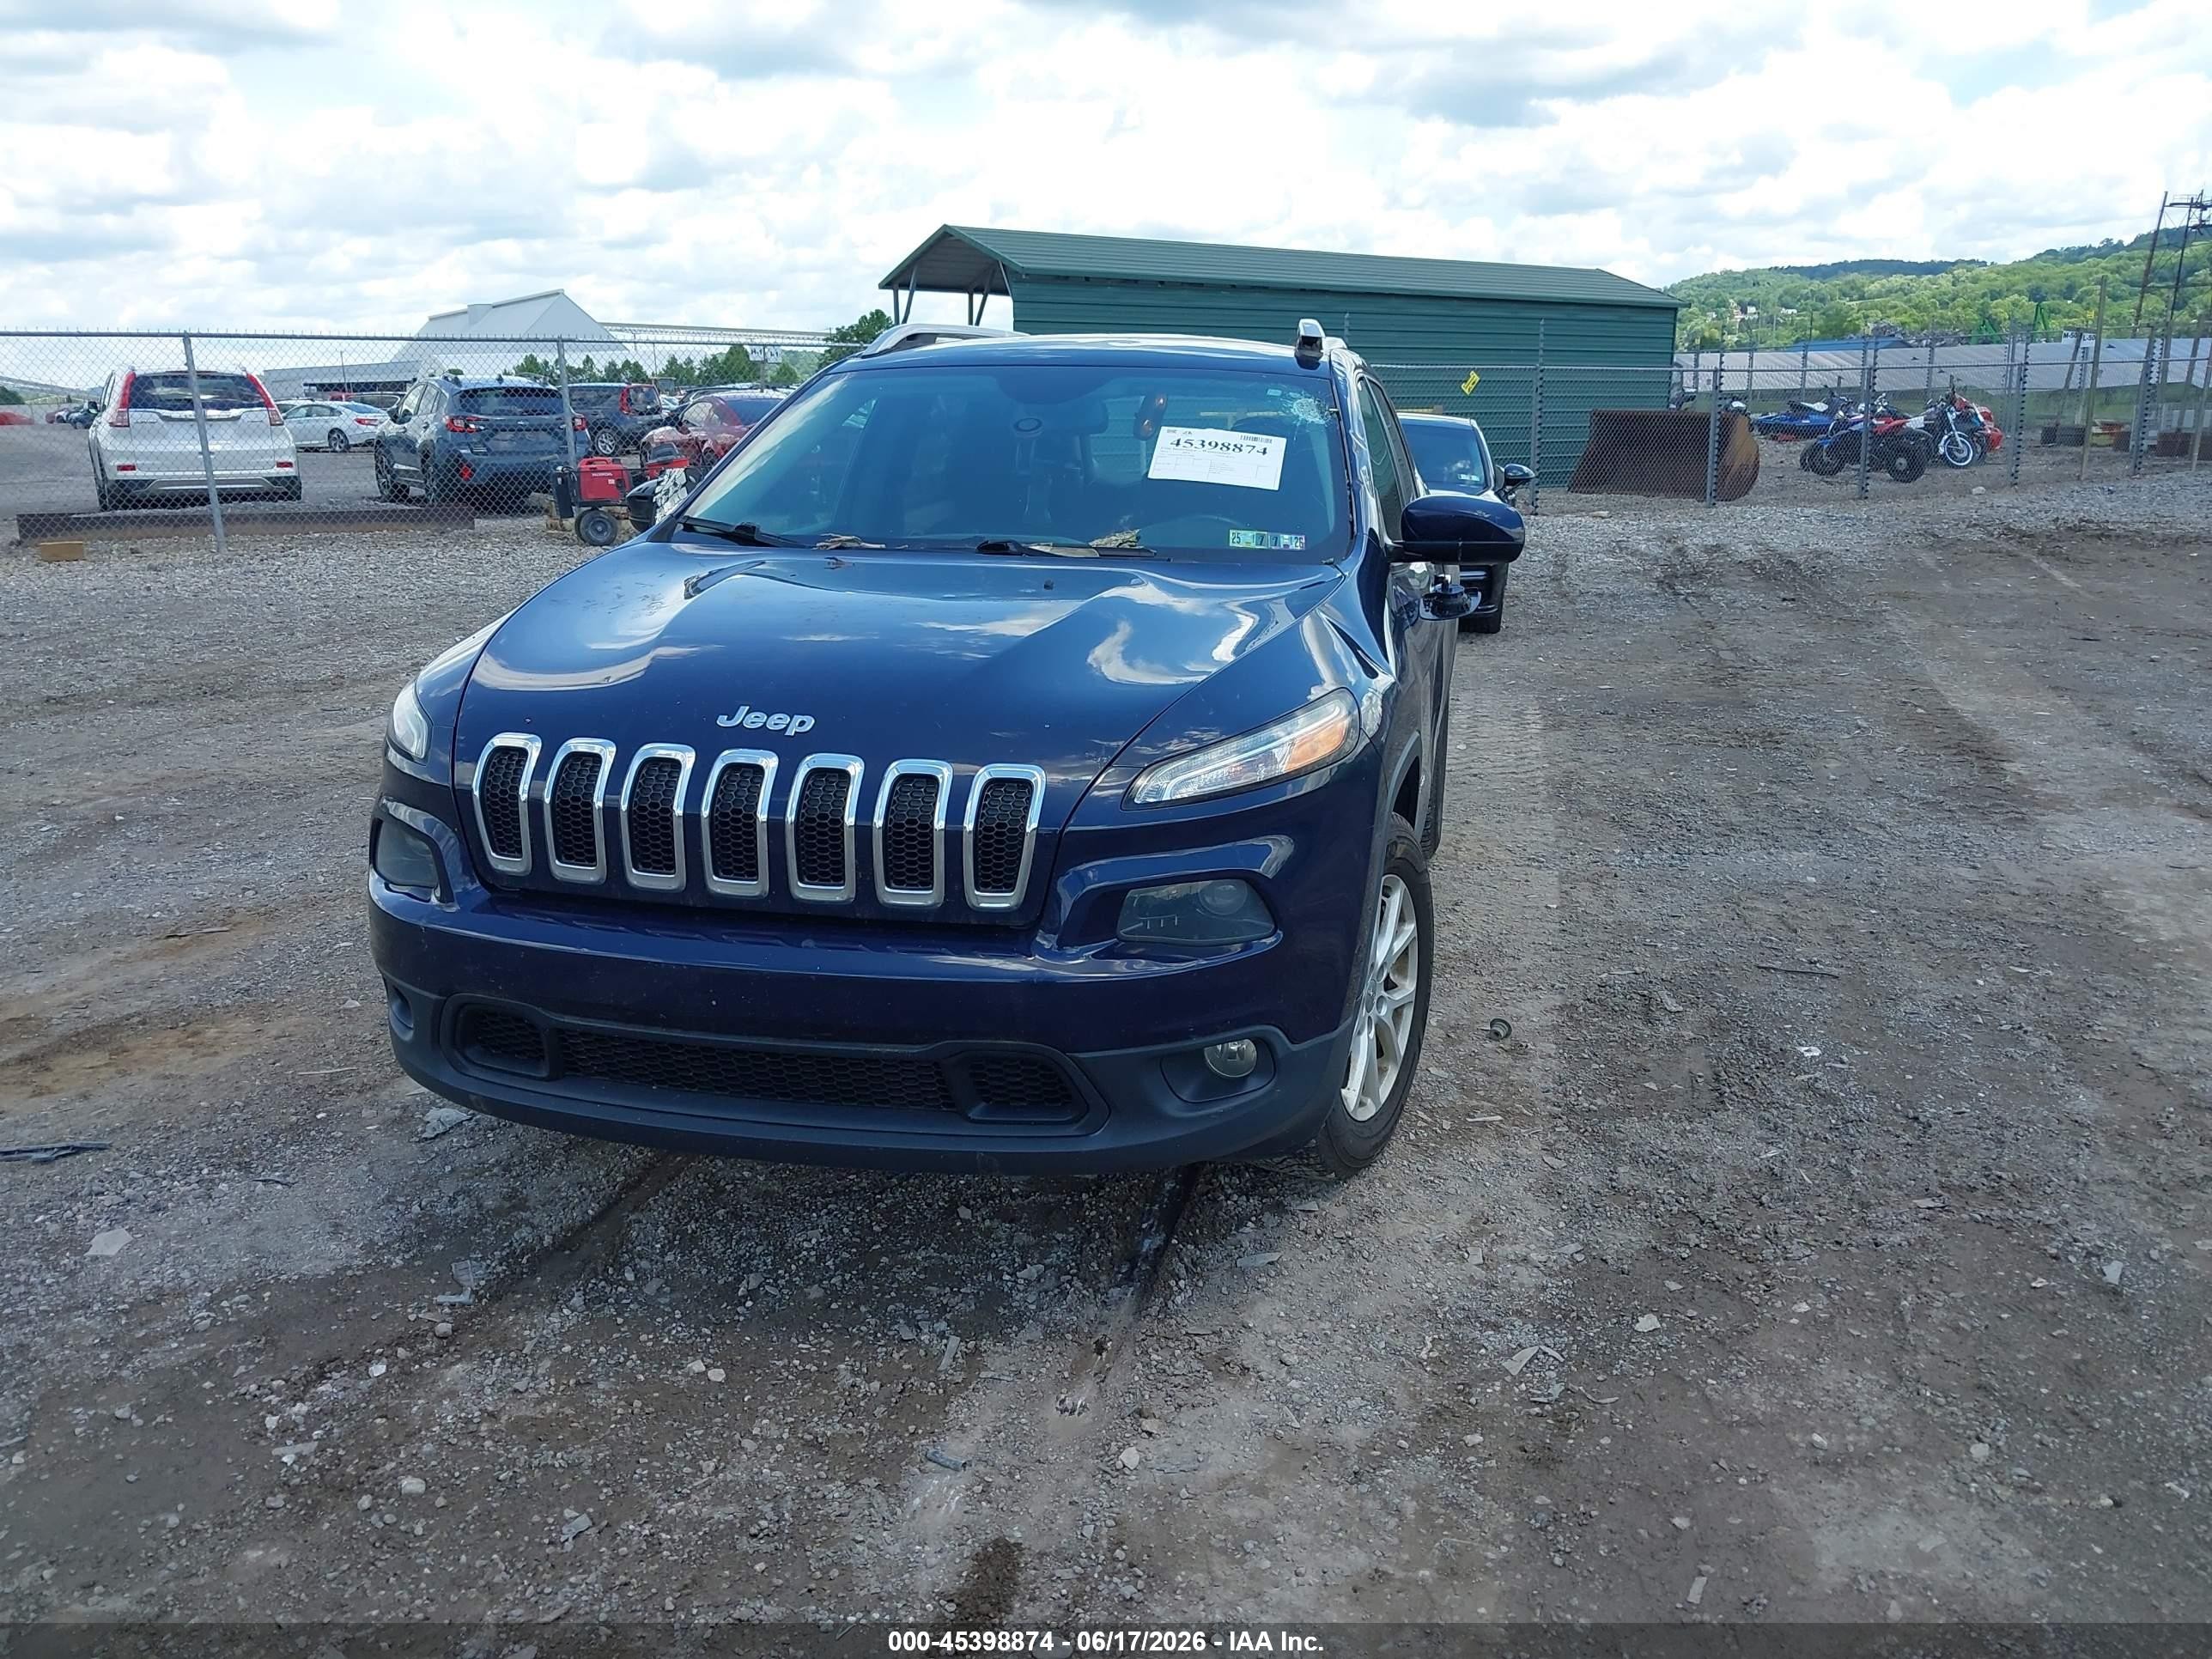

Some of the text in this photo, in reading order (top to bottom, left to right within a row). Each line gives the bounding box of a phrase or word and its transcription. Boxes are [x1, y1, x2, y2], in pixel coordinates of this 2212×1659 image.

[1170, 438, 1267, 456] 45398874
[1231, 532, 1242, 544] 25
[1294, 536, 1304, 549] 26
[716, 706, 815, 736] Jeep
